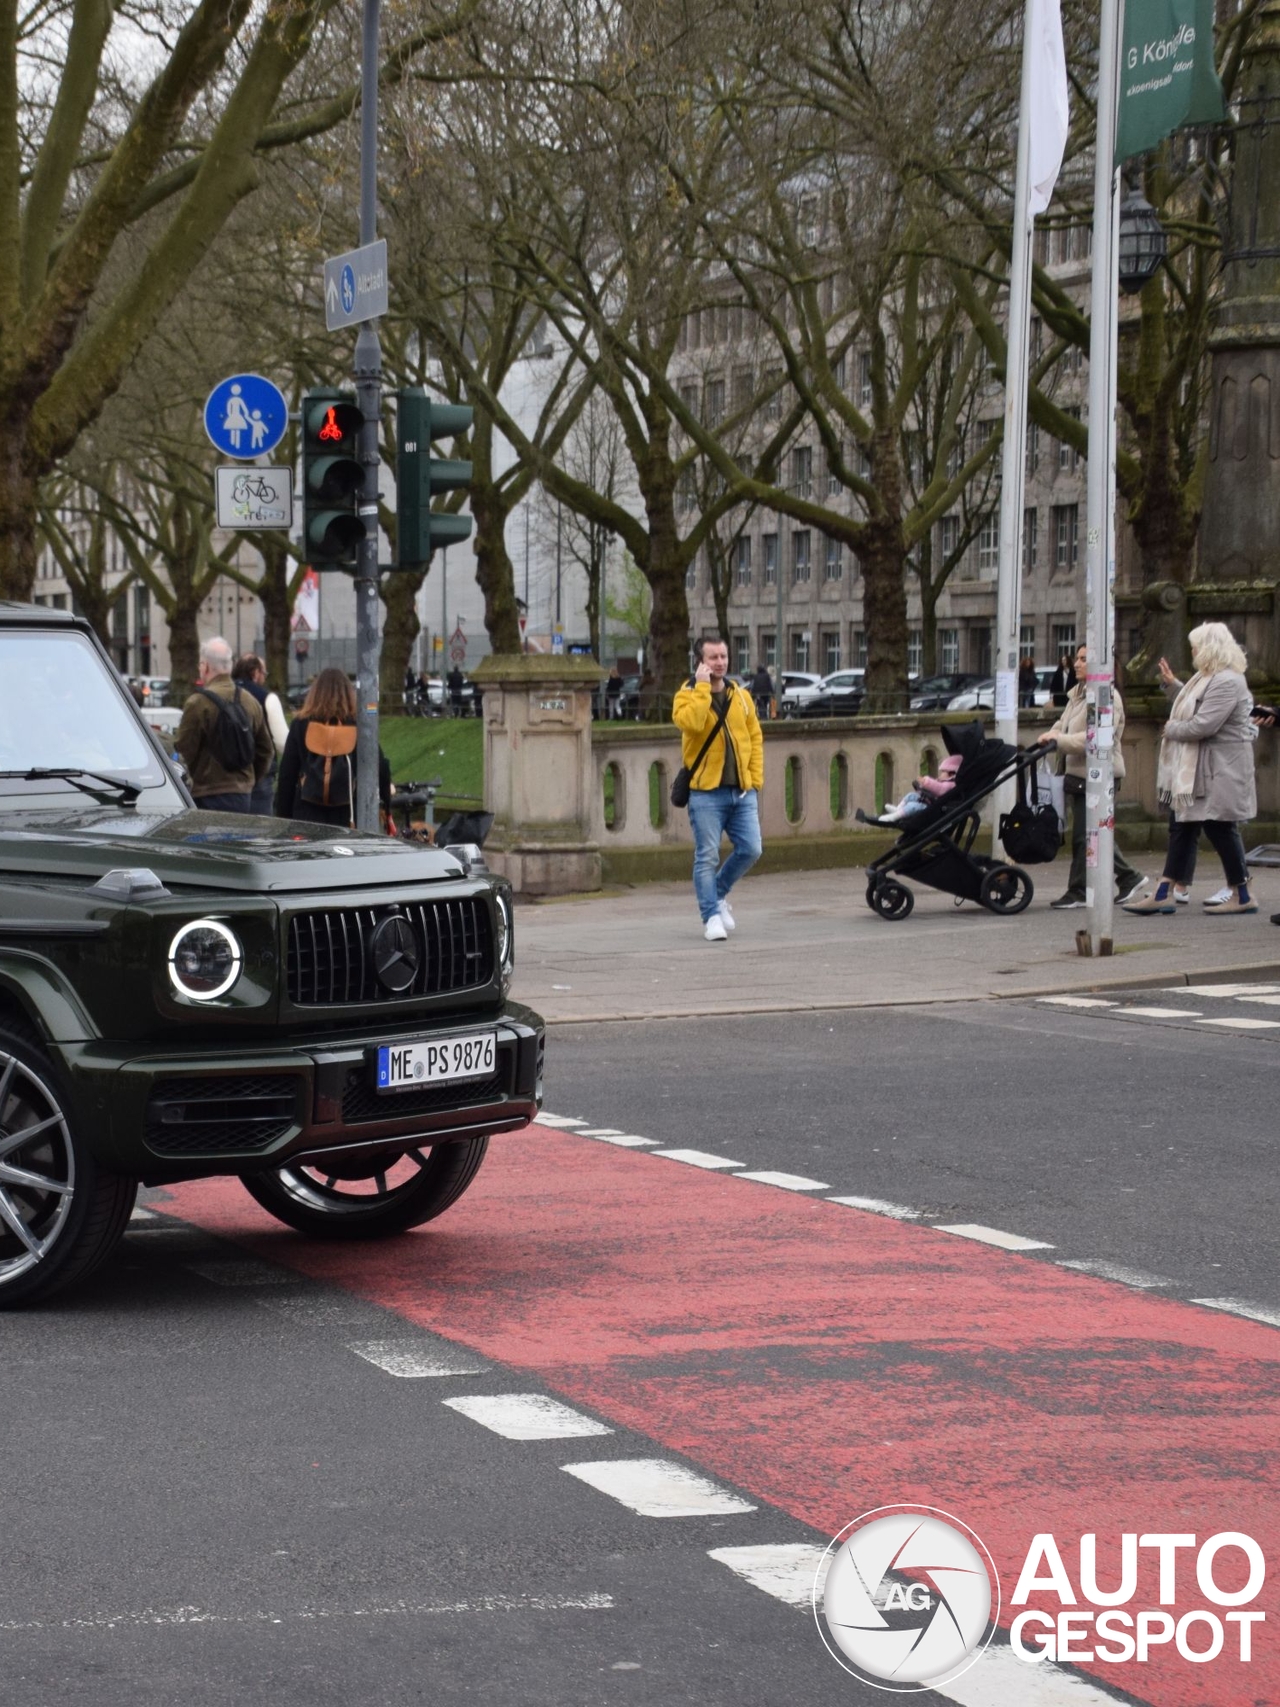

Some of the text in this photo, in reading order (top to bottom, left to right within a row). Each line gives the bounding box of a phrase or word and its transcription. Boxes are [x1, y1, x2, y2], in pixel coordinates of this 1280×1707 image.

[358, 269, 384, 295] Altstadt
[391, 1039, 493, 1081] ME PS 9876
[380, 1072, 387, 1081] D
